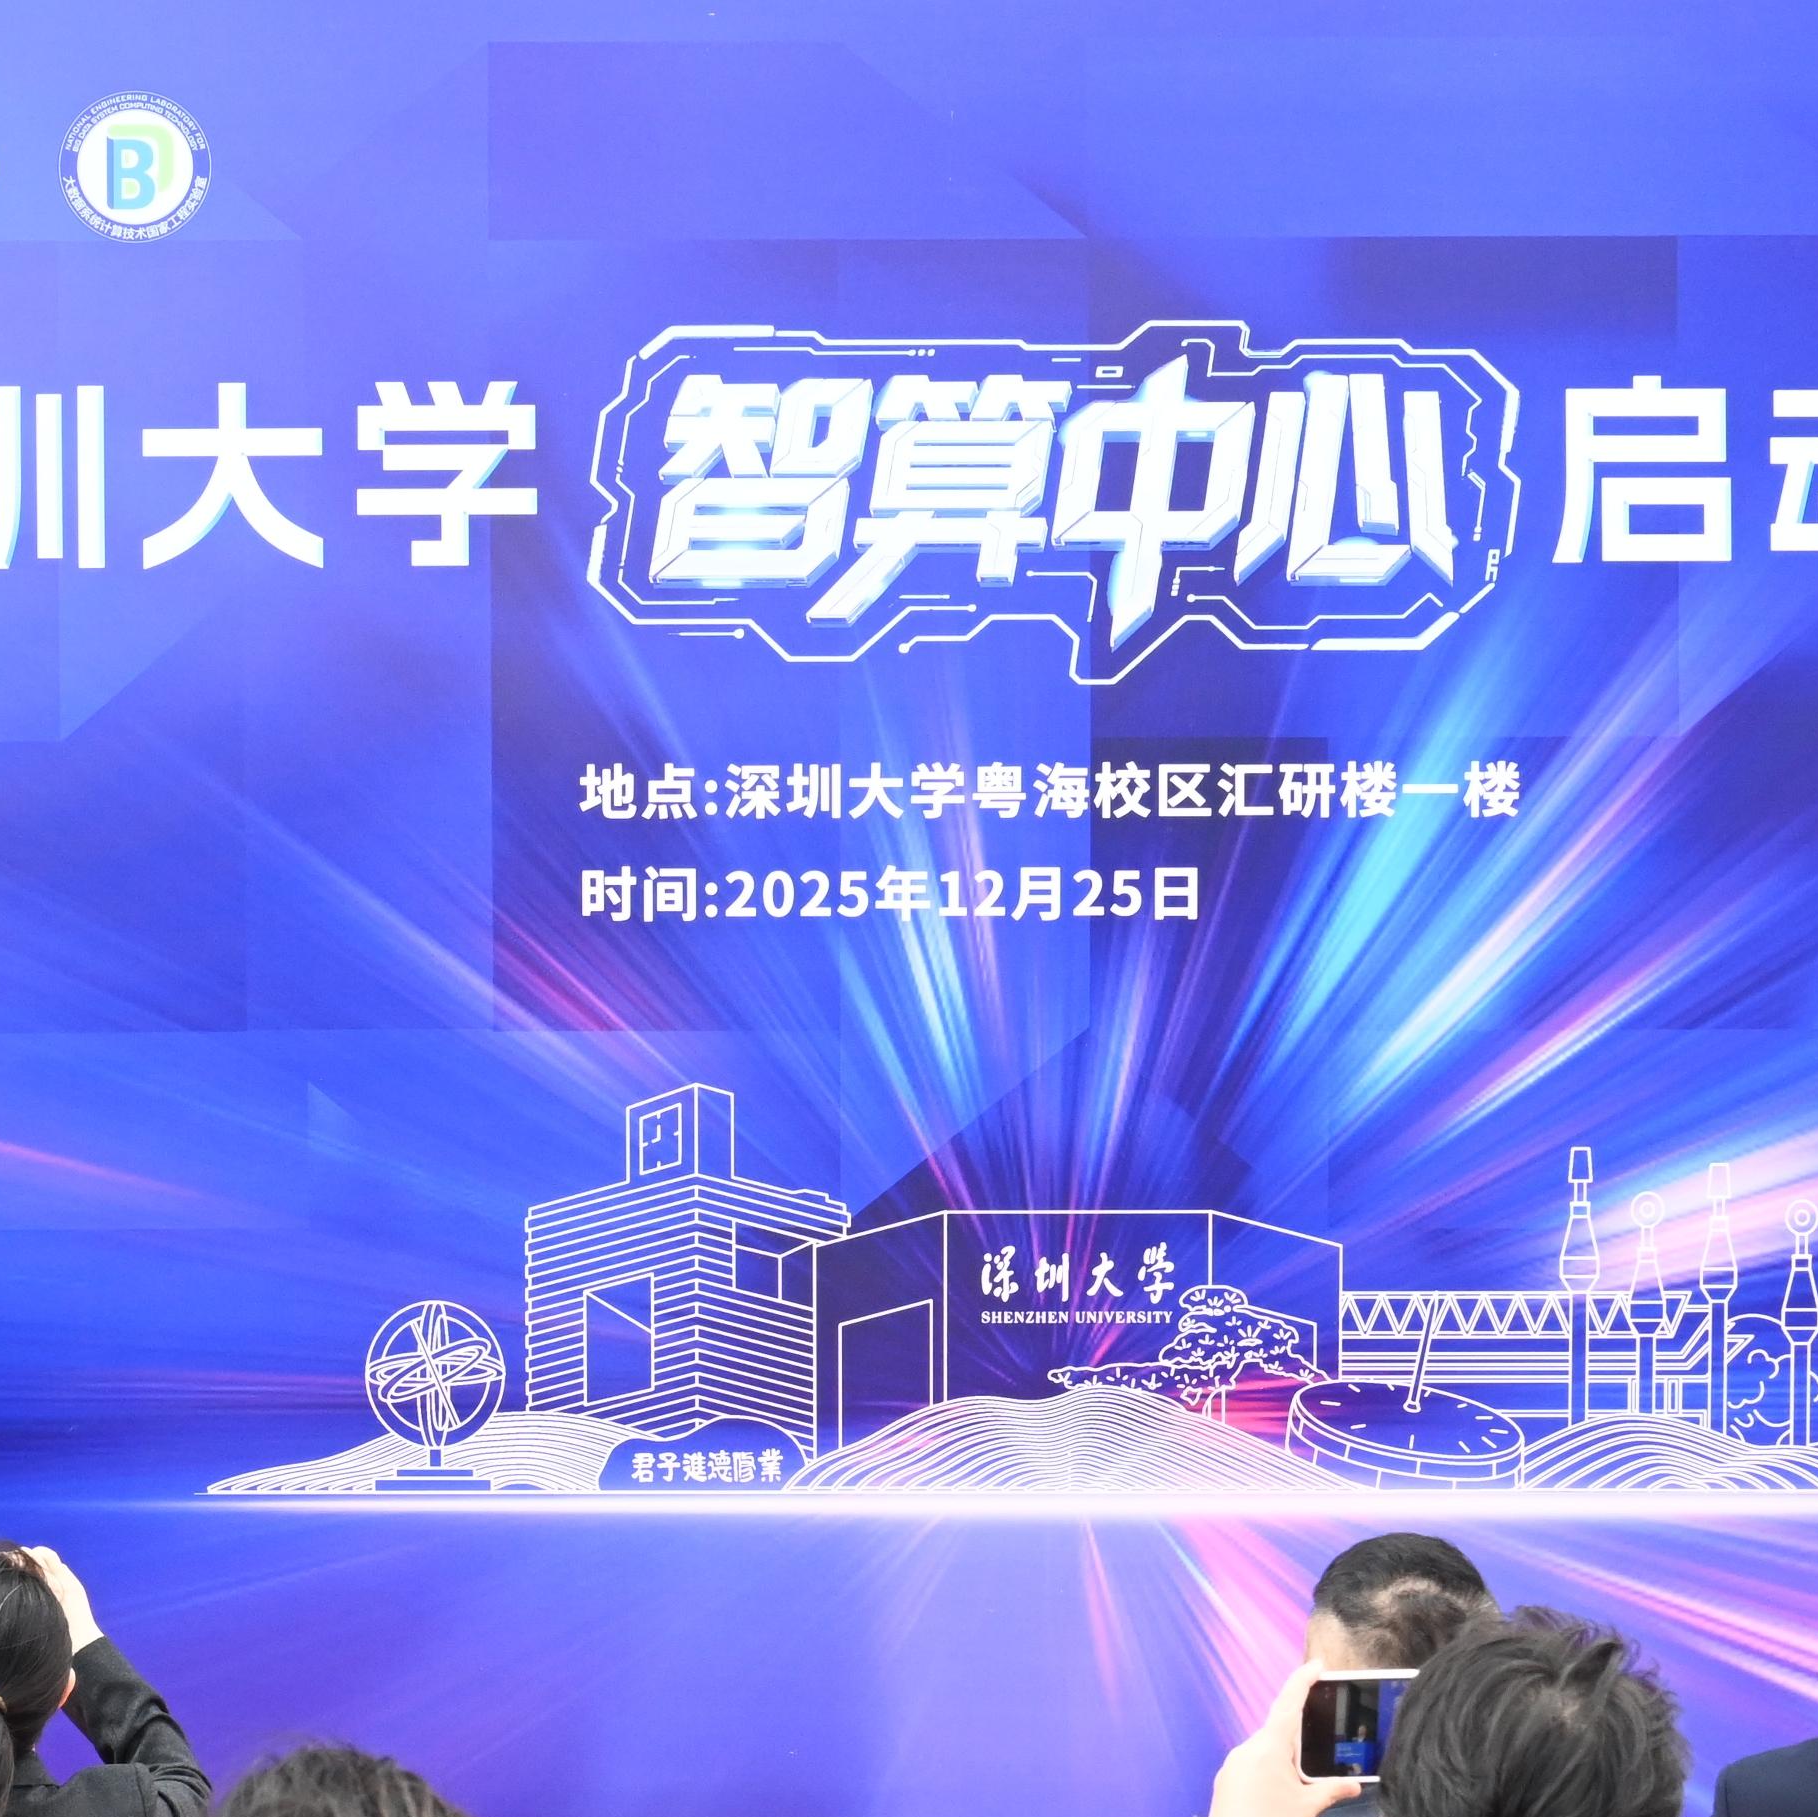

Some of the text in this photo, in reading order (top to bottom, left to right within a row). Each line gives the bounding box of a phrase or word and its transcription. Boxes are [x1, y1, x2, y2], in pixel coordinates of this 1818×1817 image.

[65, 93, 206, 151] NATIONAL ENGINEERING LABORATORY FOR
[91, 105, 119, 124] SYSTEM
[649, 354, 1460, 652] 智算中心
[578, 762, 1522, 822] 地点:深圳大学粤海校区汇研楼一楼
[581, 864, 1202, 923] 时间:2025年12月25日
[980, 1310, 1174, 1325] SHENZHEN UNIVERSITY
